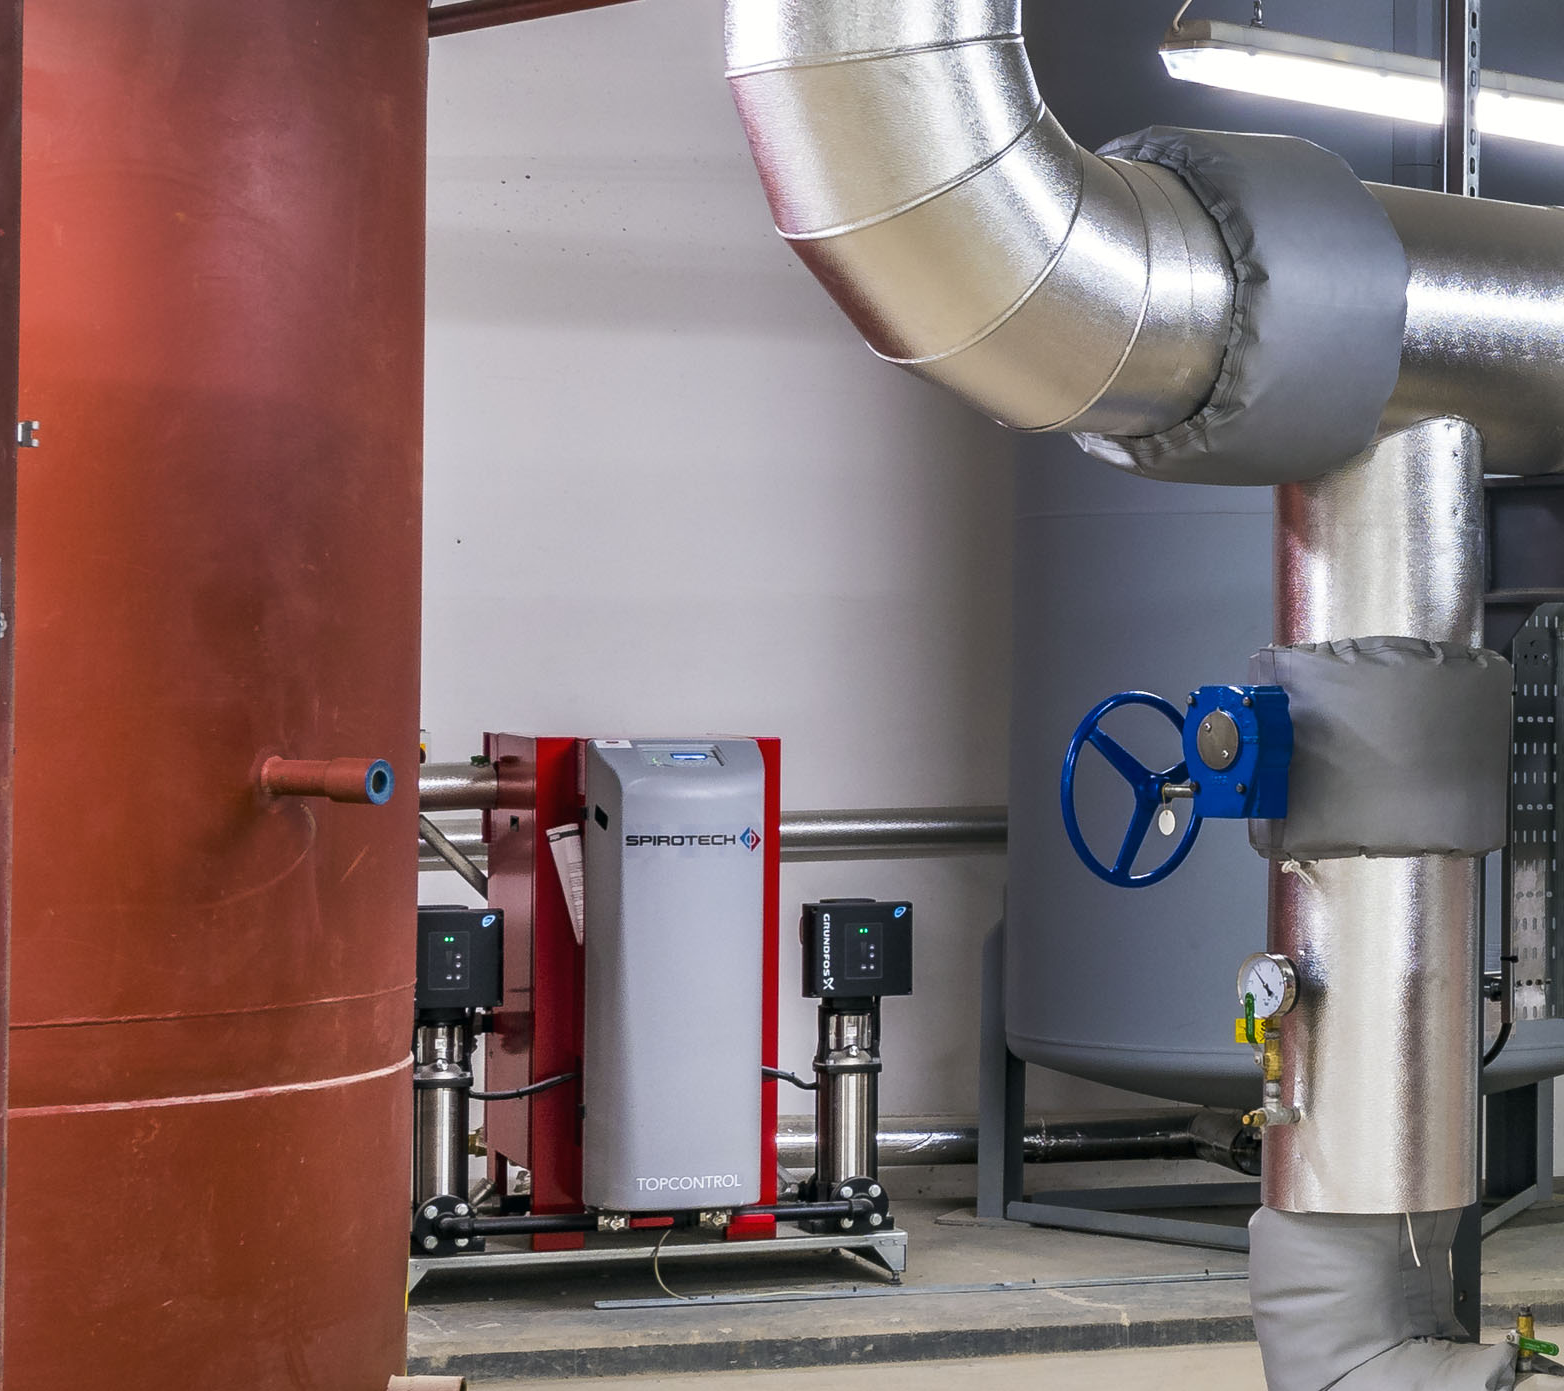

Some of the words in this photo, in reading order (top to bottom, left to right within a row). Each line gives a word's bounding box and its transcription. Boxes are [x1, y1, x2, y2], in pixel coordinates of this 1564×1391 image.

[625, 833, 737, 847] SPIROTECH
[822, 912, 831, 976] GRUNDFOS
[636, 1174, 742, 1192] TOPCONTROL
